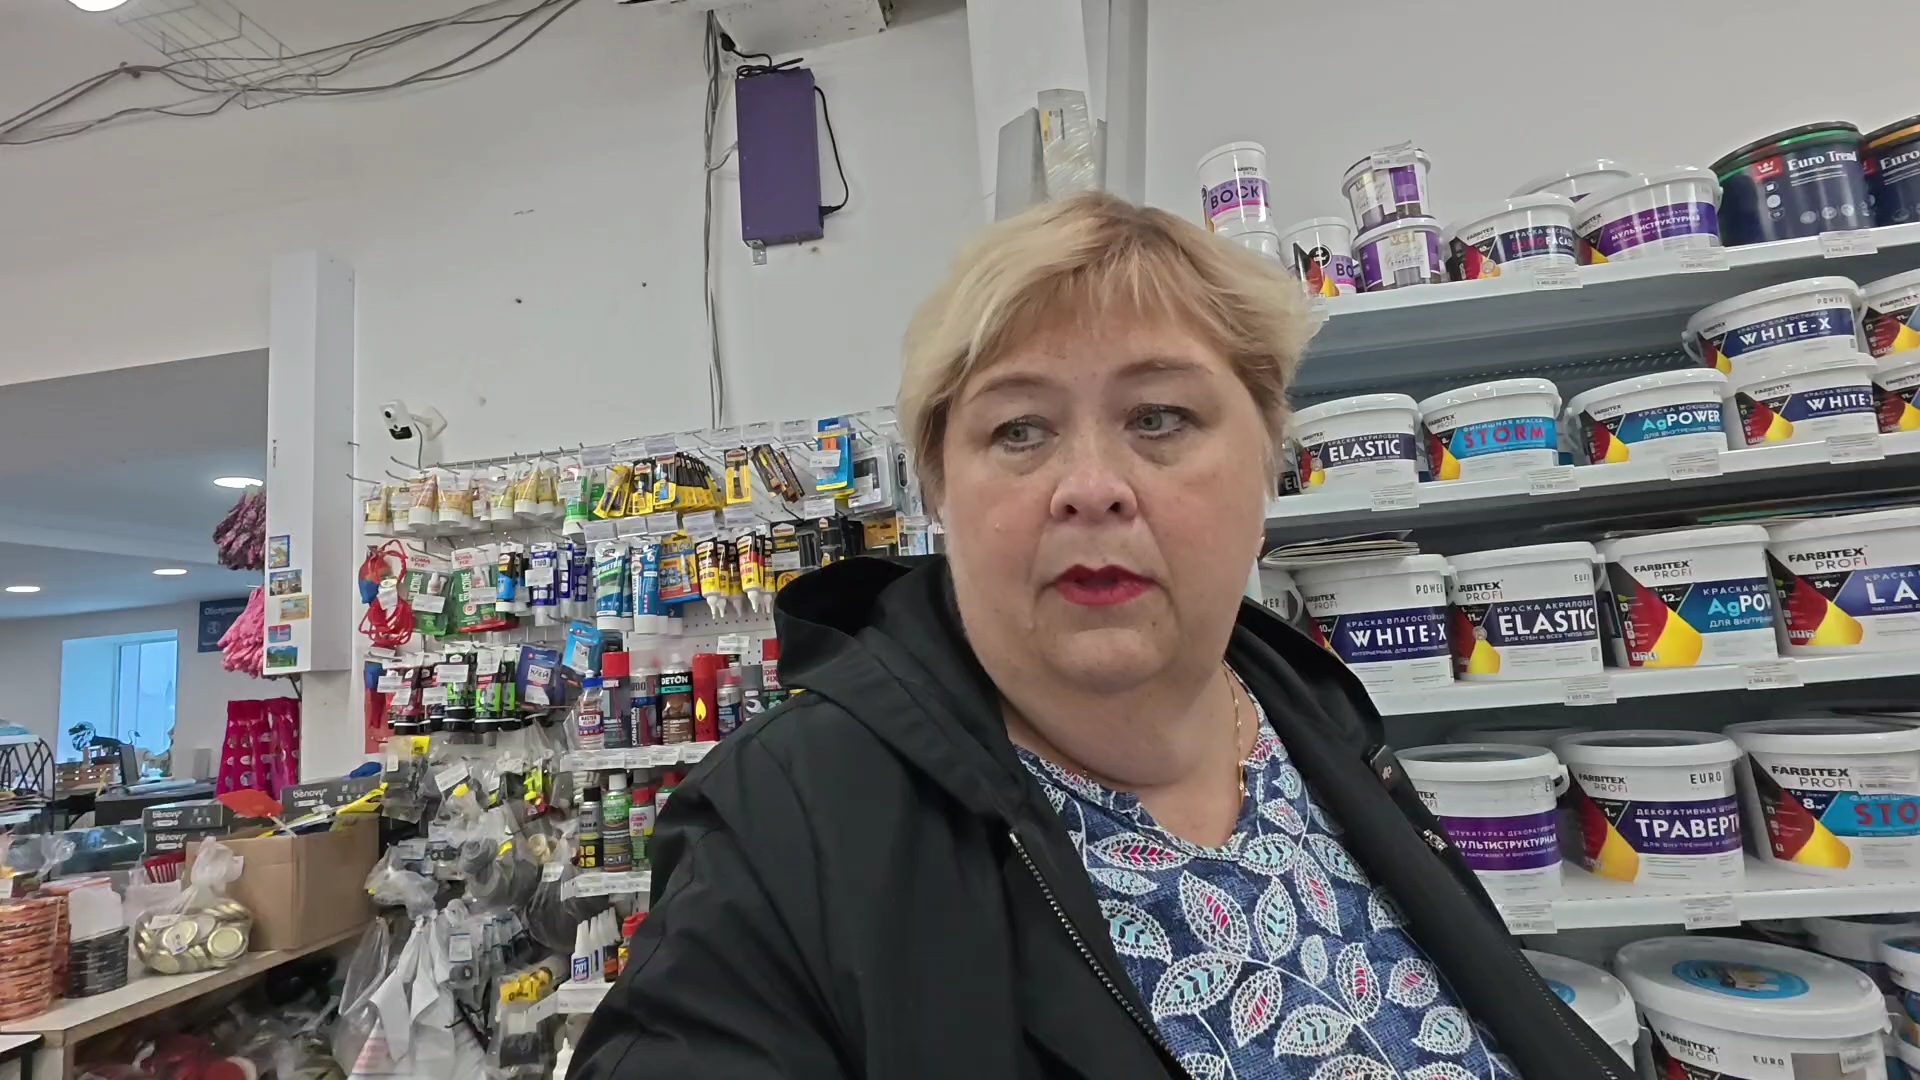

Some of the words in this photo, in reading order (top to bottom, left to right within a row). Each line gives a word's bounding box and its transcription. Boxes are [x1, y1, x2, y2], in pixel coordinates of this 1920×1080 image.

[1788, 155, 1825, 171] Euro
[1826, 150, 1858, 163] Trend
[1880, 150, 1920, 171] Euro
[1739, 317, 1832, 347] WHITE-X
[1754, 383, 1791, 395] FARBITEX
[1638, 407, 1675, 417] КРАСКА
[1428, 413, 1456, 427] FARBITEX
[1436, 420, 1457, 430] PROFI
[1462, 419, 1514, 432] ФИНИШНАЯ
[1642, 410, 1720, 431] AgPOWER
[1327, 438, 1356, 446] КРАСКА
[1358, 433, 1400, 442] АКРИЛОВАЯ
[1464, 424, 1544, 449] STORM
[1328, 440, 1400, 463] ELASTIC
[1788, 547, 1864, 563] FARBITEX
[1633, 560, 1690, 573] FARBITEX
[1815, 557, 1868, 570] PROFI
[1653, 569, 1693, 580] PROFI
[1864, 571, 1914, 582] КРАСКА
[1466, 592, 1503, 601] PROFI
[1703, 585, 1748, 596] КРАСКА
[1314, 602, 1337, 611] PROFI
[1496, 603, 1541, 613] КРАСКА
[1346, 618, 1383, 628] КРАСКА
[1498, 608, 1596, 636] ELASTIC
[1709, 618, 1731, 629] ДЛЯ
[1349, 623, 1447, 648] WHITE-X
[530, 668, 549, 678] КЛЕЙ
[661, 675, 689, 685] DETON
[630, 707, 638, 746] СМЫВКА
[1690, 771, 1722, 785] EURO
[1771, 765, 1850, 778] FARBITEX
[1578, 773, 1626, 785] FARBITEX
[1800, 776, 1852, 788] PROFI
[1594, 783, 1628, 793] PROFI
[1636, 807, 1717, 816] ДЕКОРАТИВНАЯ
[1854, 801, 1920, 826] STO
[1660, 1031, 1717, 1055] FARBITEX
[1680, 1046, 1719, 1064] PROFI
[1752, 1055, 1785, 1066] EURO
